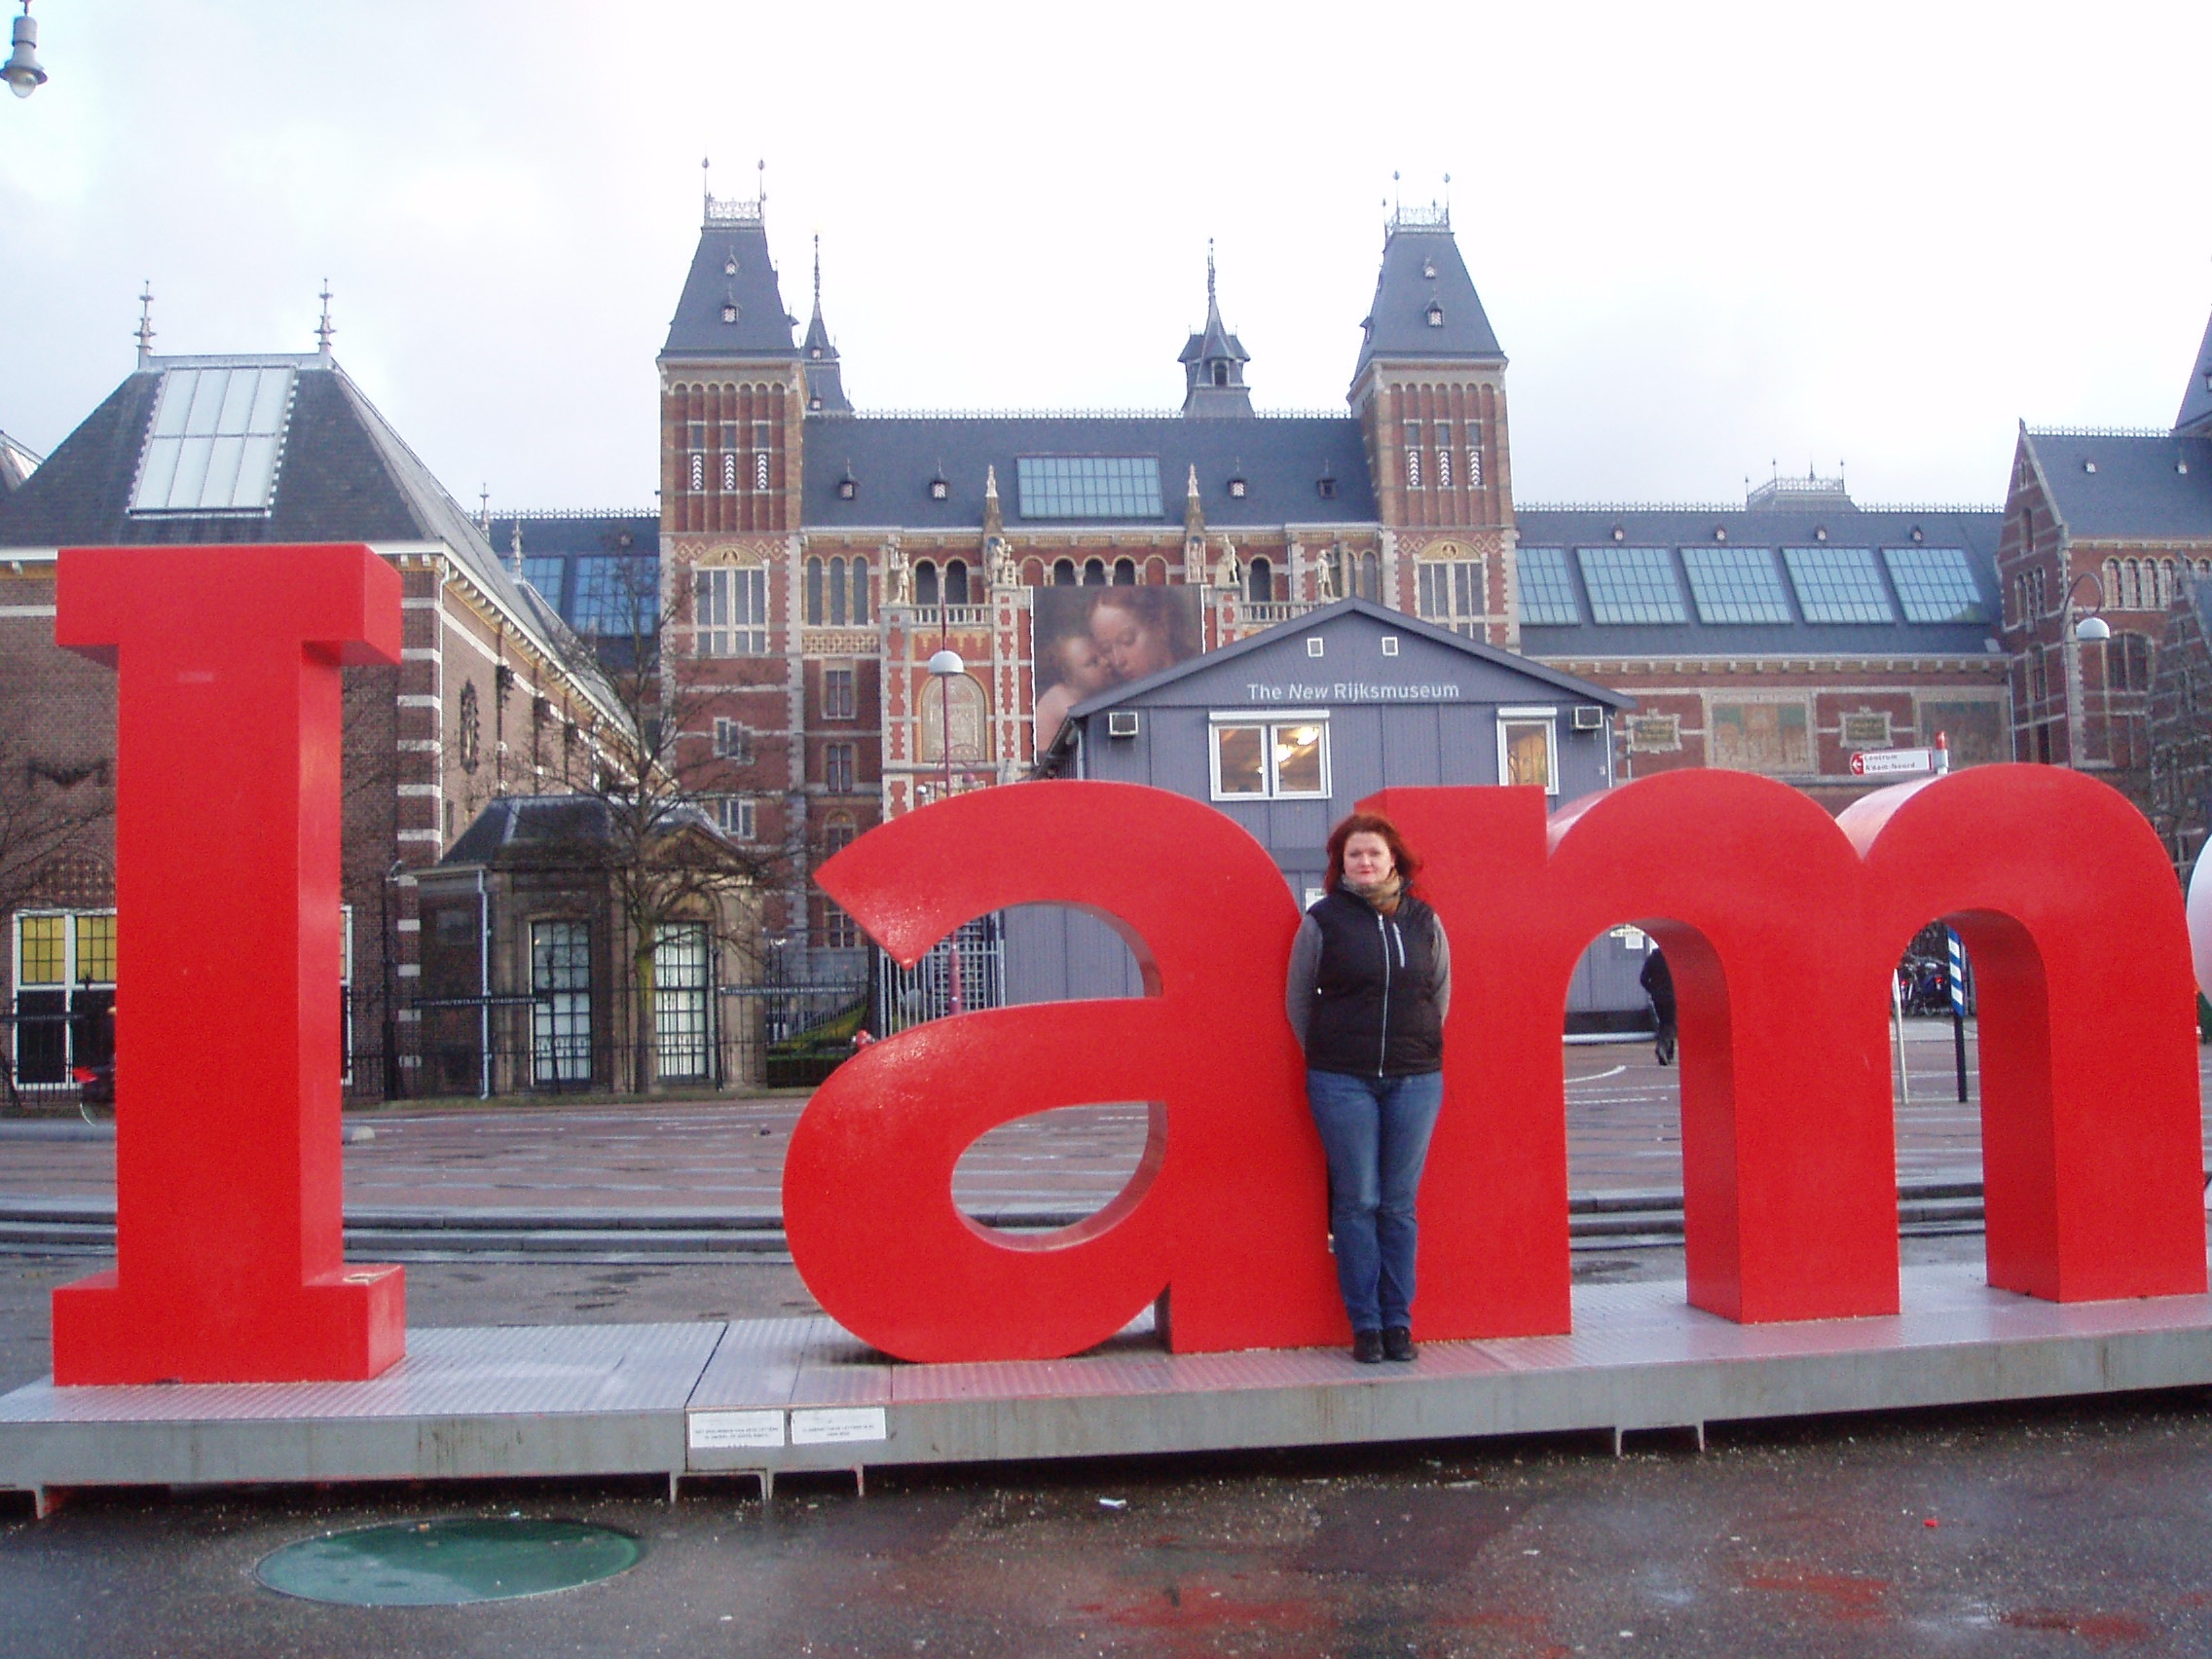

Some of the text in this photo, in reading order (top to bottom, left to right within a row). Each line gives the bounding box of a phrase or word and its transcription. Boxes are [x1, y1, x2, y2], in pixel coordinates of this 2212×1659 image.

[1247, 682, 1459, 702] The New Rijksmuseum
[53, 544, 2207, 1385] I am
